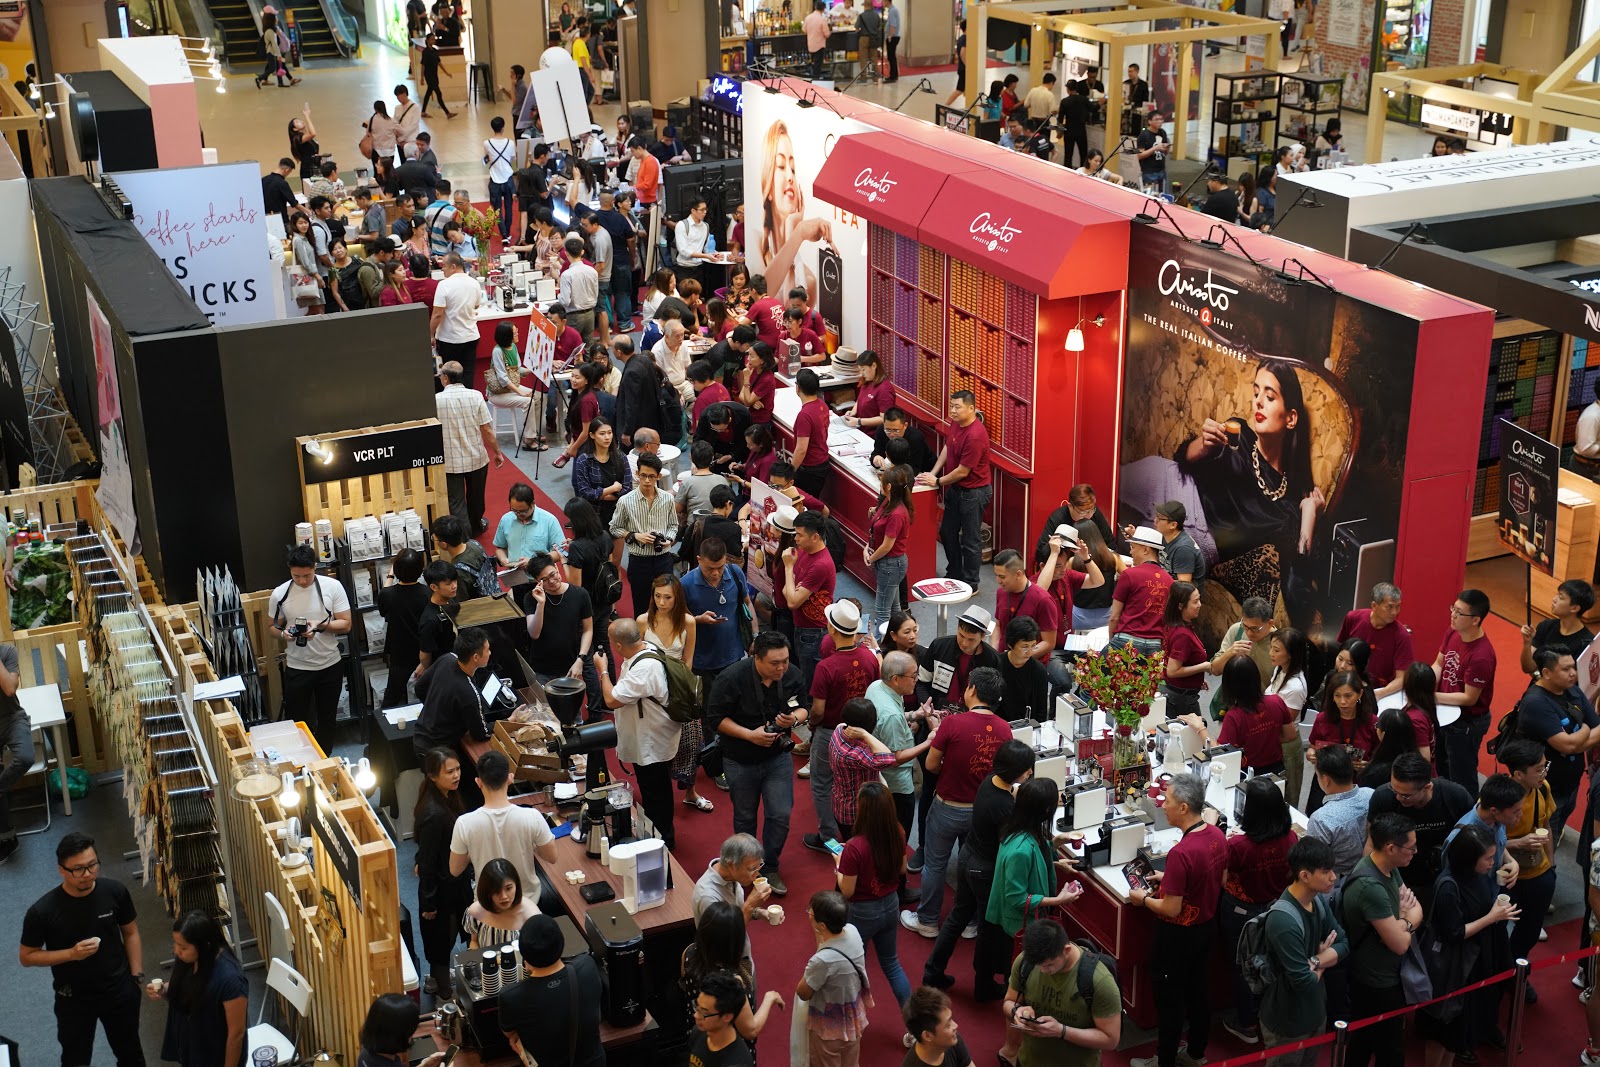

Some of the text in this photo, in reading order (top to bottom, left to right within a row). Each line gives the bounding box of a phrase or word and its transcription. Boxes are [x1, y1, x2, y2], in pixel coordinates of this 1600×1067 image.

[1502, 113, 1512, 129] T
[1445, 161, 1544, 178] ONLINE
[203, 197, 258, 232] starts
[1170, 299, 1199, 316] ARISSTO
[1213, 316, 1234, 330] ITALY
[1143, 313, 1247, 363] THE REAL ITALIAN COFFEE
[353, 446, 395, 463] VCR PLT
[412, 458, 425, 467] D01
[430, 455, 444, 465] D02
[1520, 460, 1534, 472] COFFEE
